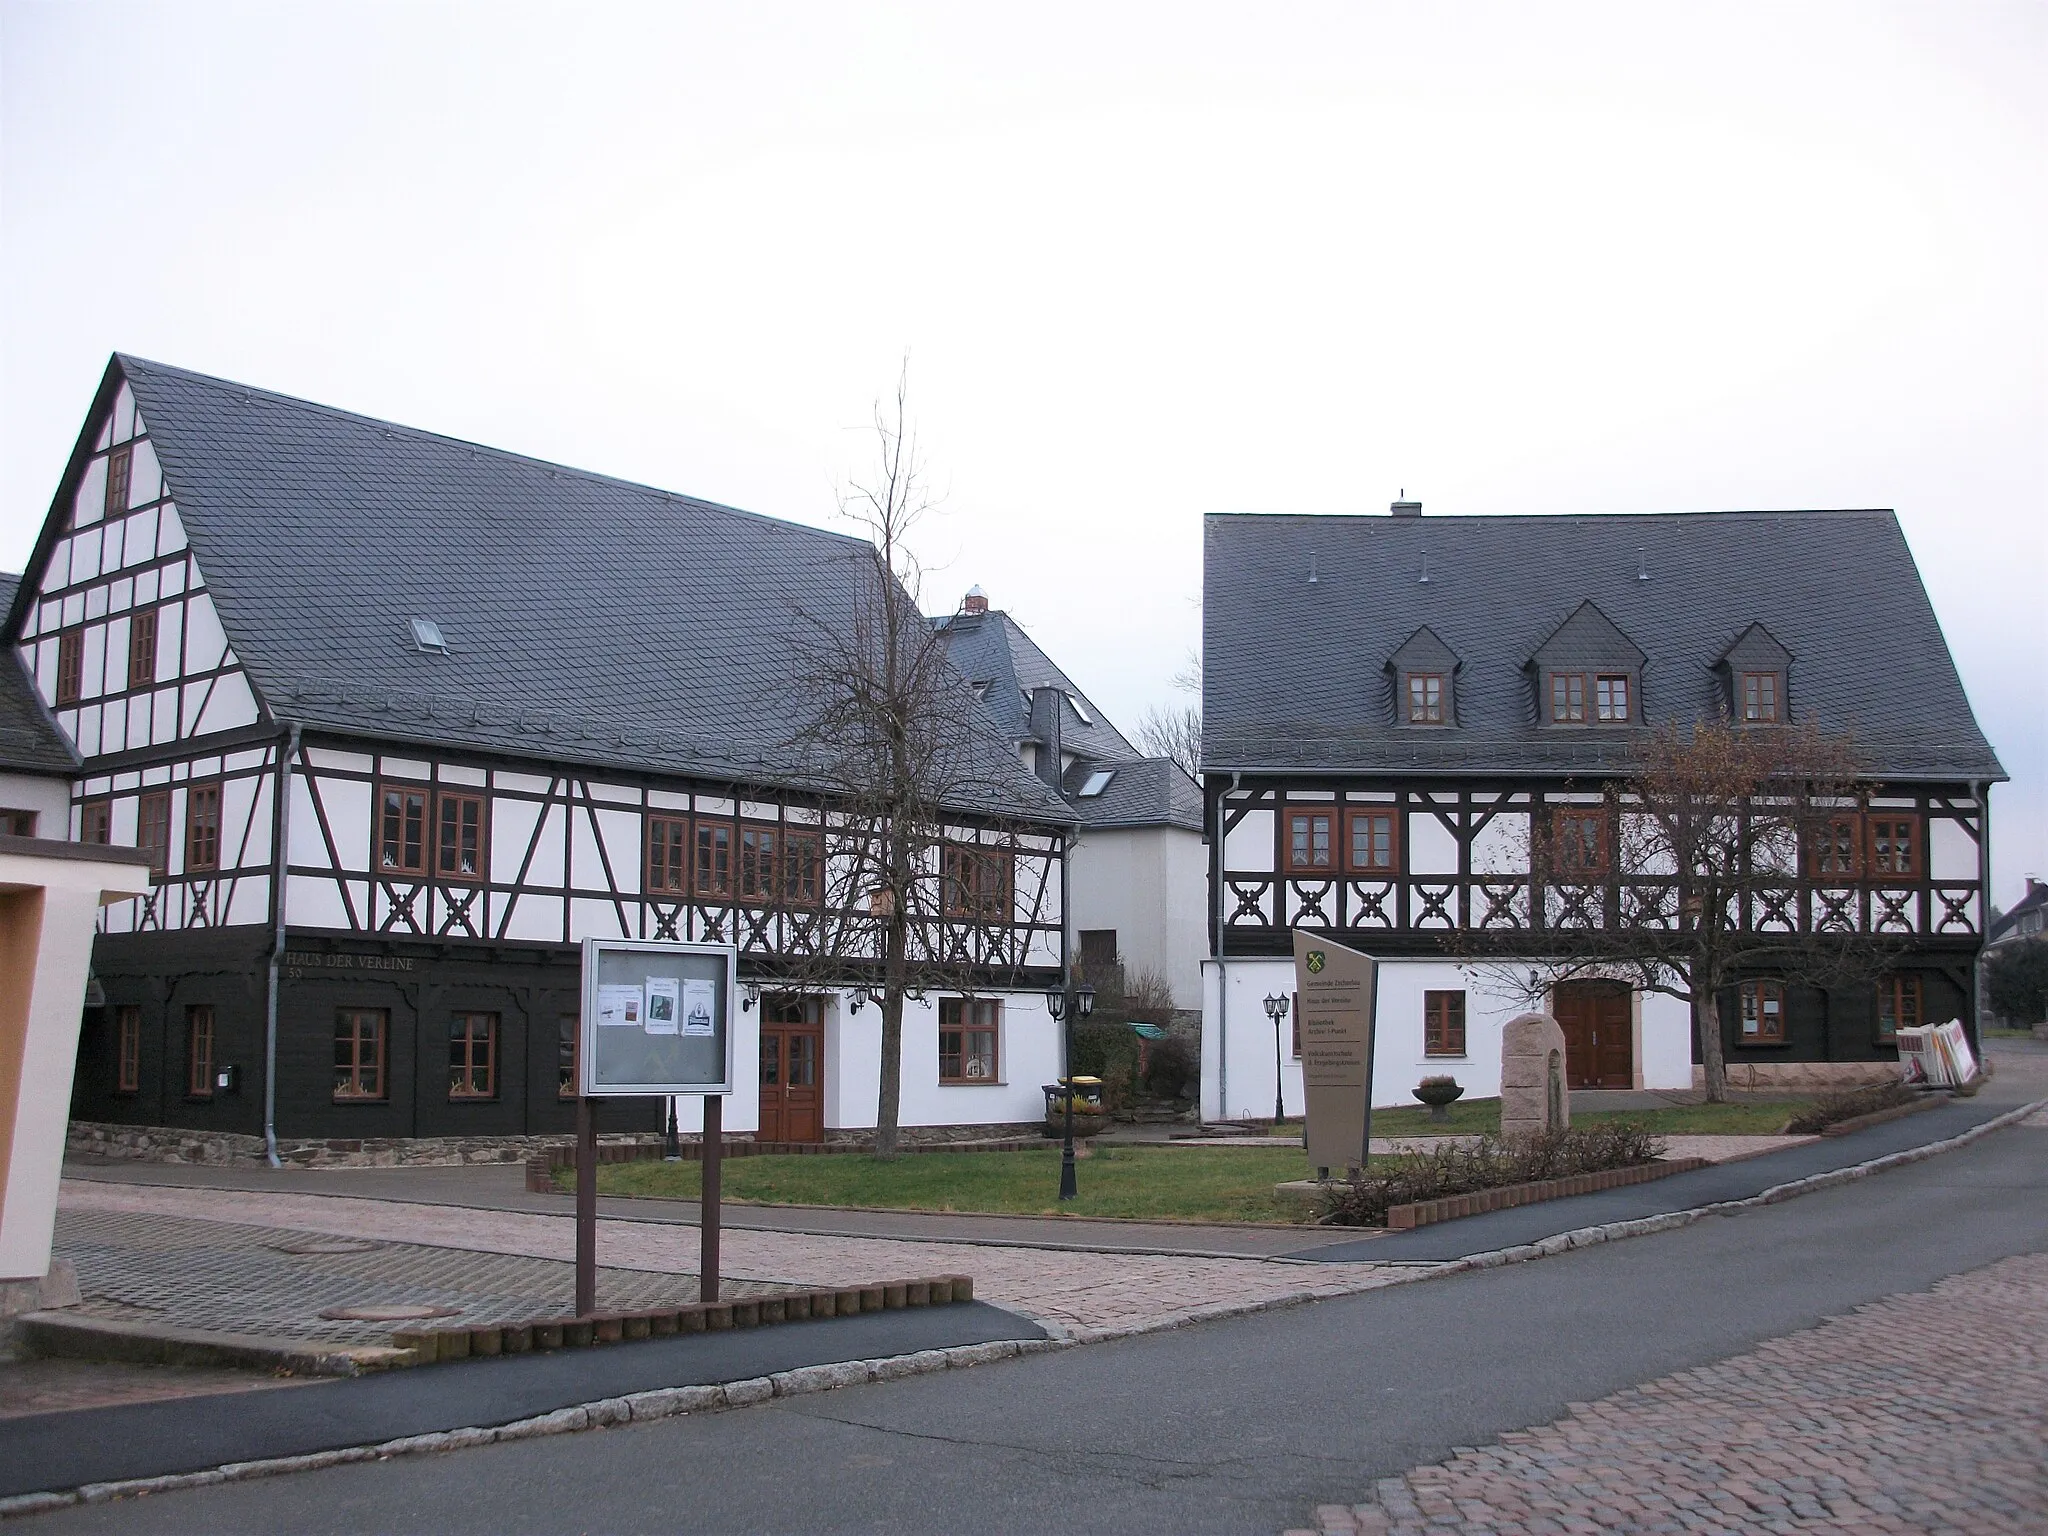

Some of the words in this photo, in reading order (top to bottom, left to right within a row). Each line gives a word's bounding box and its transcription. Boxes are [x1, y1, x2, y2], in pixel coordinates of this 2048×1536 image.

[286, 952, 321, 966] HAUS
[327, 954, 353, 967] DER
[358, 956, 413, 970] VEREINE
